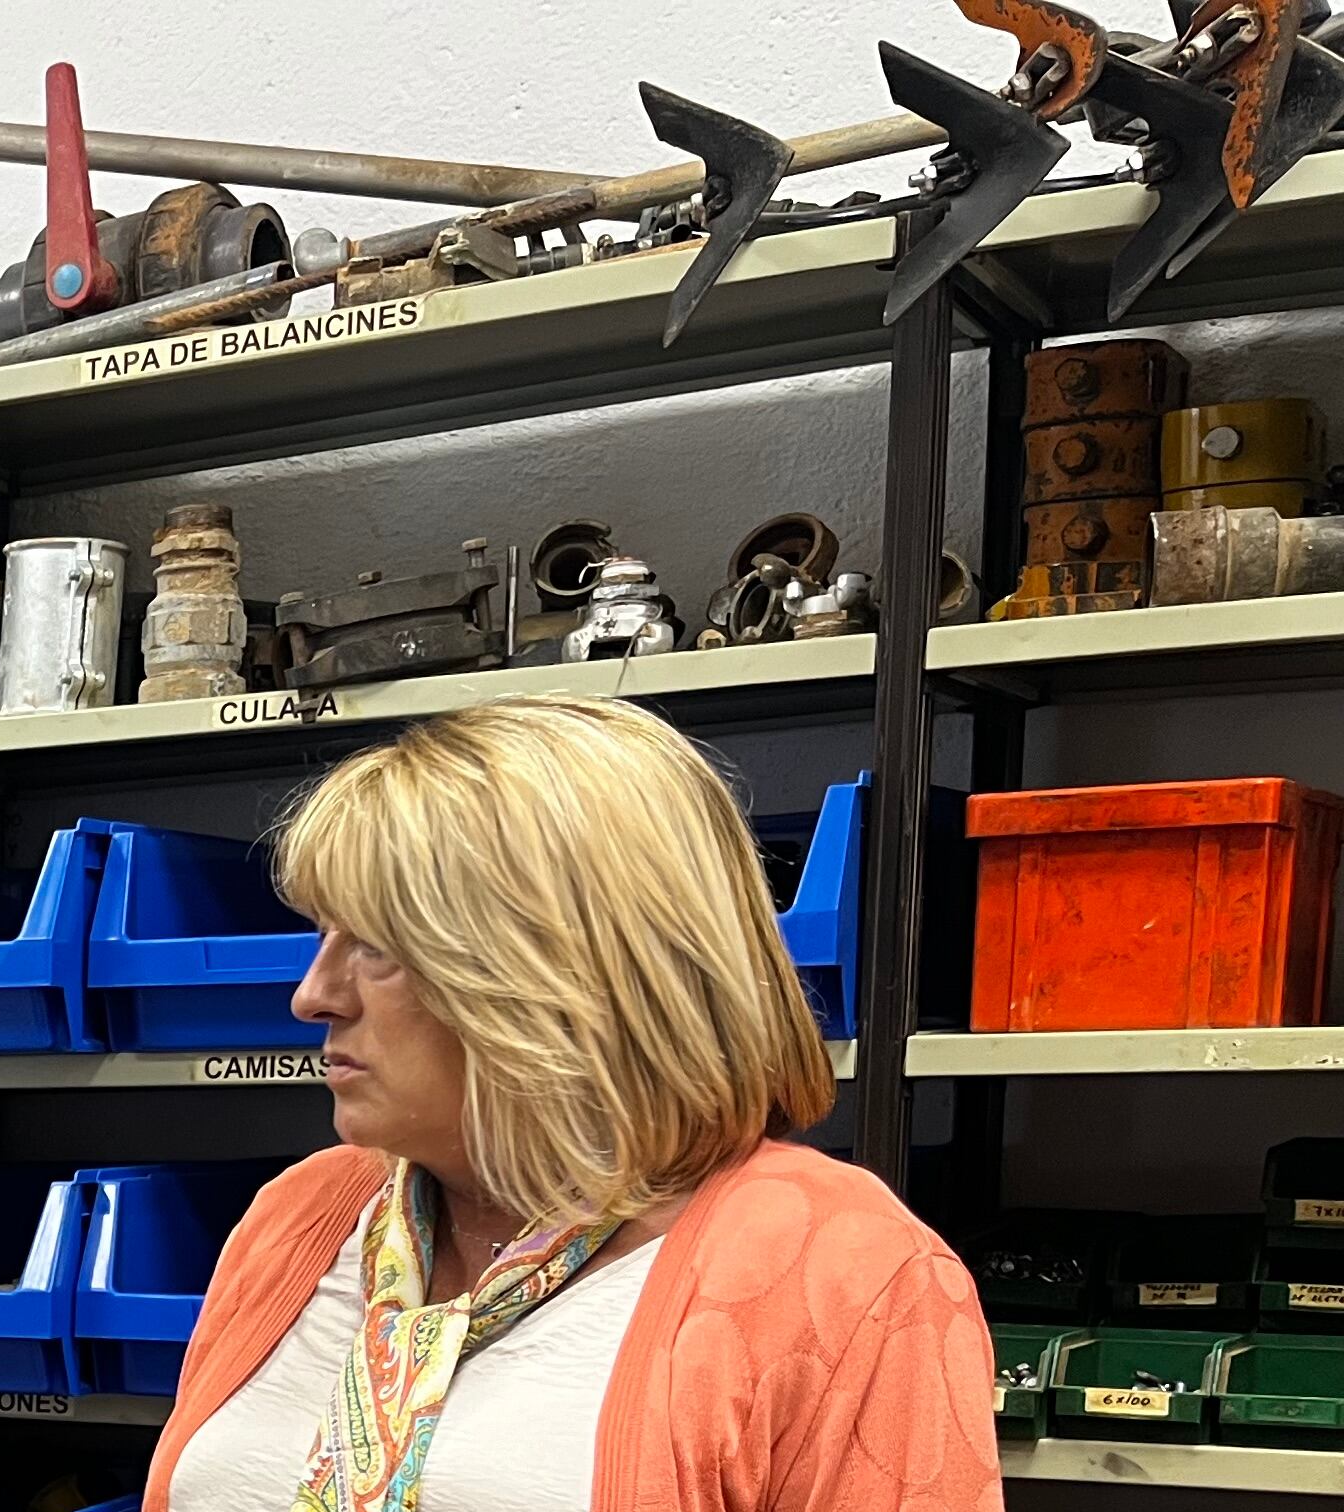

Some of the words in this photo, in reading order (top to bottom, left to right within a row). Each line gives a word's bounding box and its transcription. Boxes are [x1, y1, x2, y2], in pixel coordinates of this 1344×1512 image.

[85, 347, 160, 381] TAPA
[169, 337, 209, 366] DE
[220, 300, 419, 357] BALANCINES
[219, 692, 339, 724] CULAA
